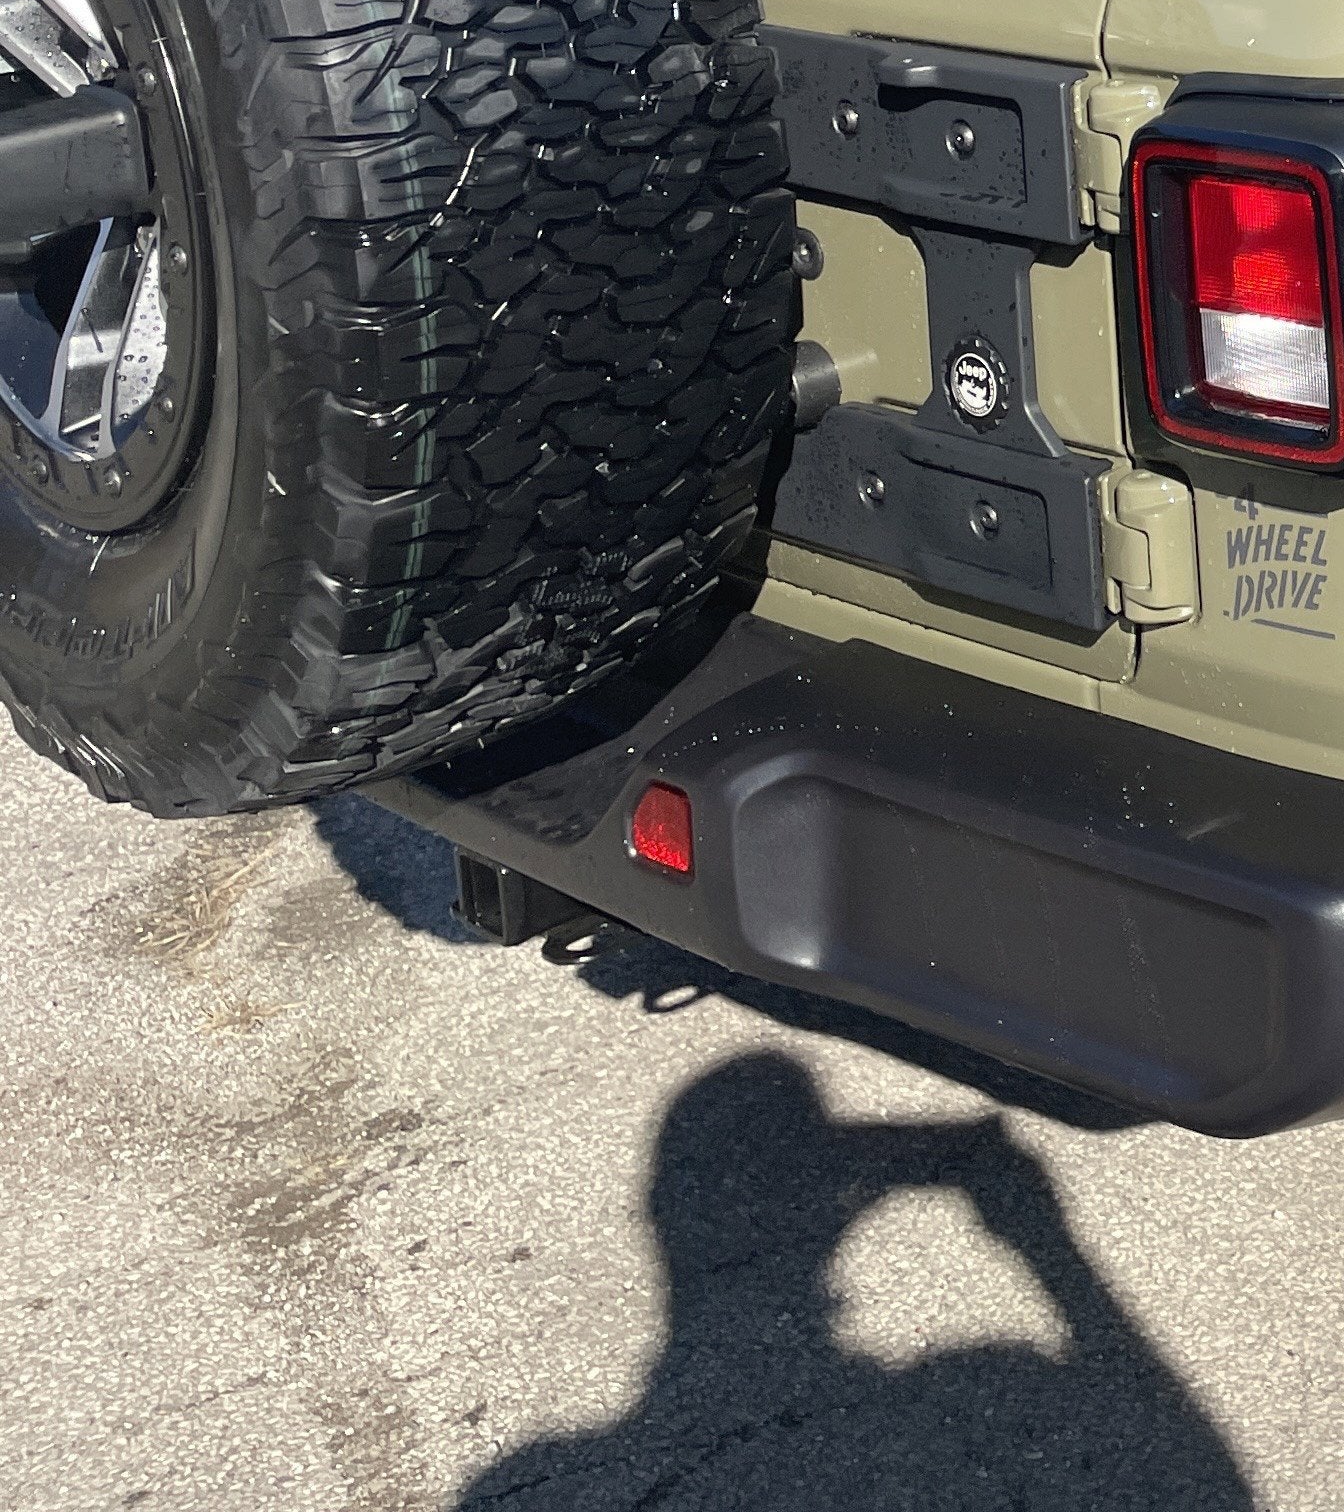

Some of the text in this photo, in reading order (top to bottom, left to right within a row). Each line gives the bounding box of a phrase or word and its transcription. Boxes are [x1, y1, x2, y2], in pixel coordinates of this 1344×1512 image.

[958, 360, 988, 382] Jeep
[1233, 483, 1258, 521] 4
[1226, 523, 1328, 570] WHEEL
[1232, 569, 1328, 621] DRIVE
